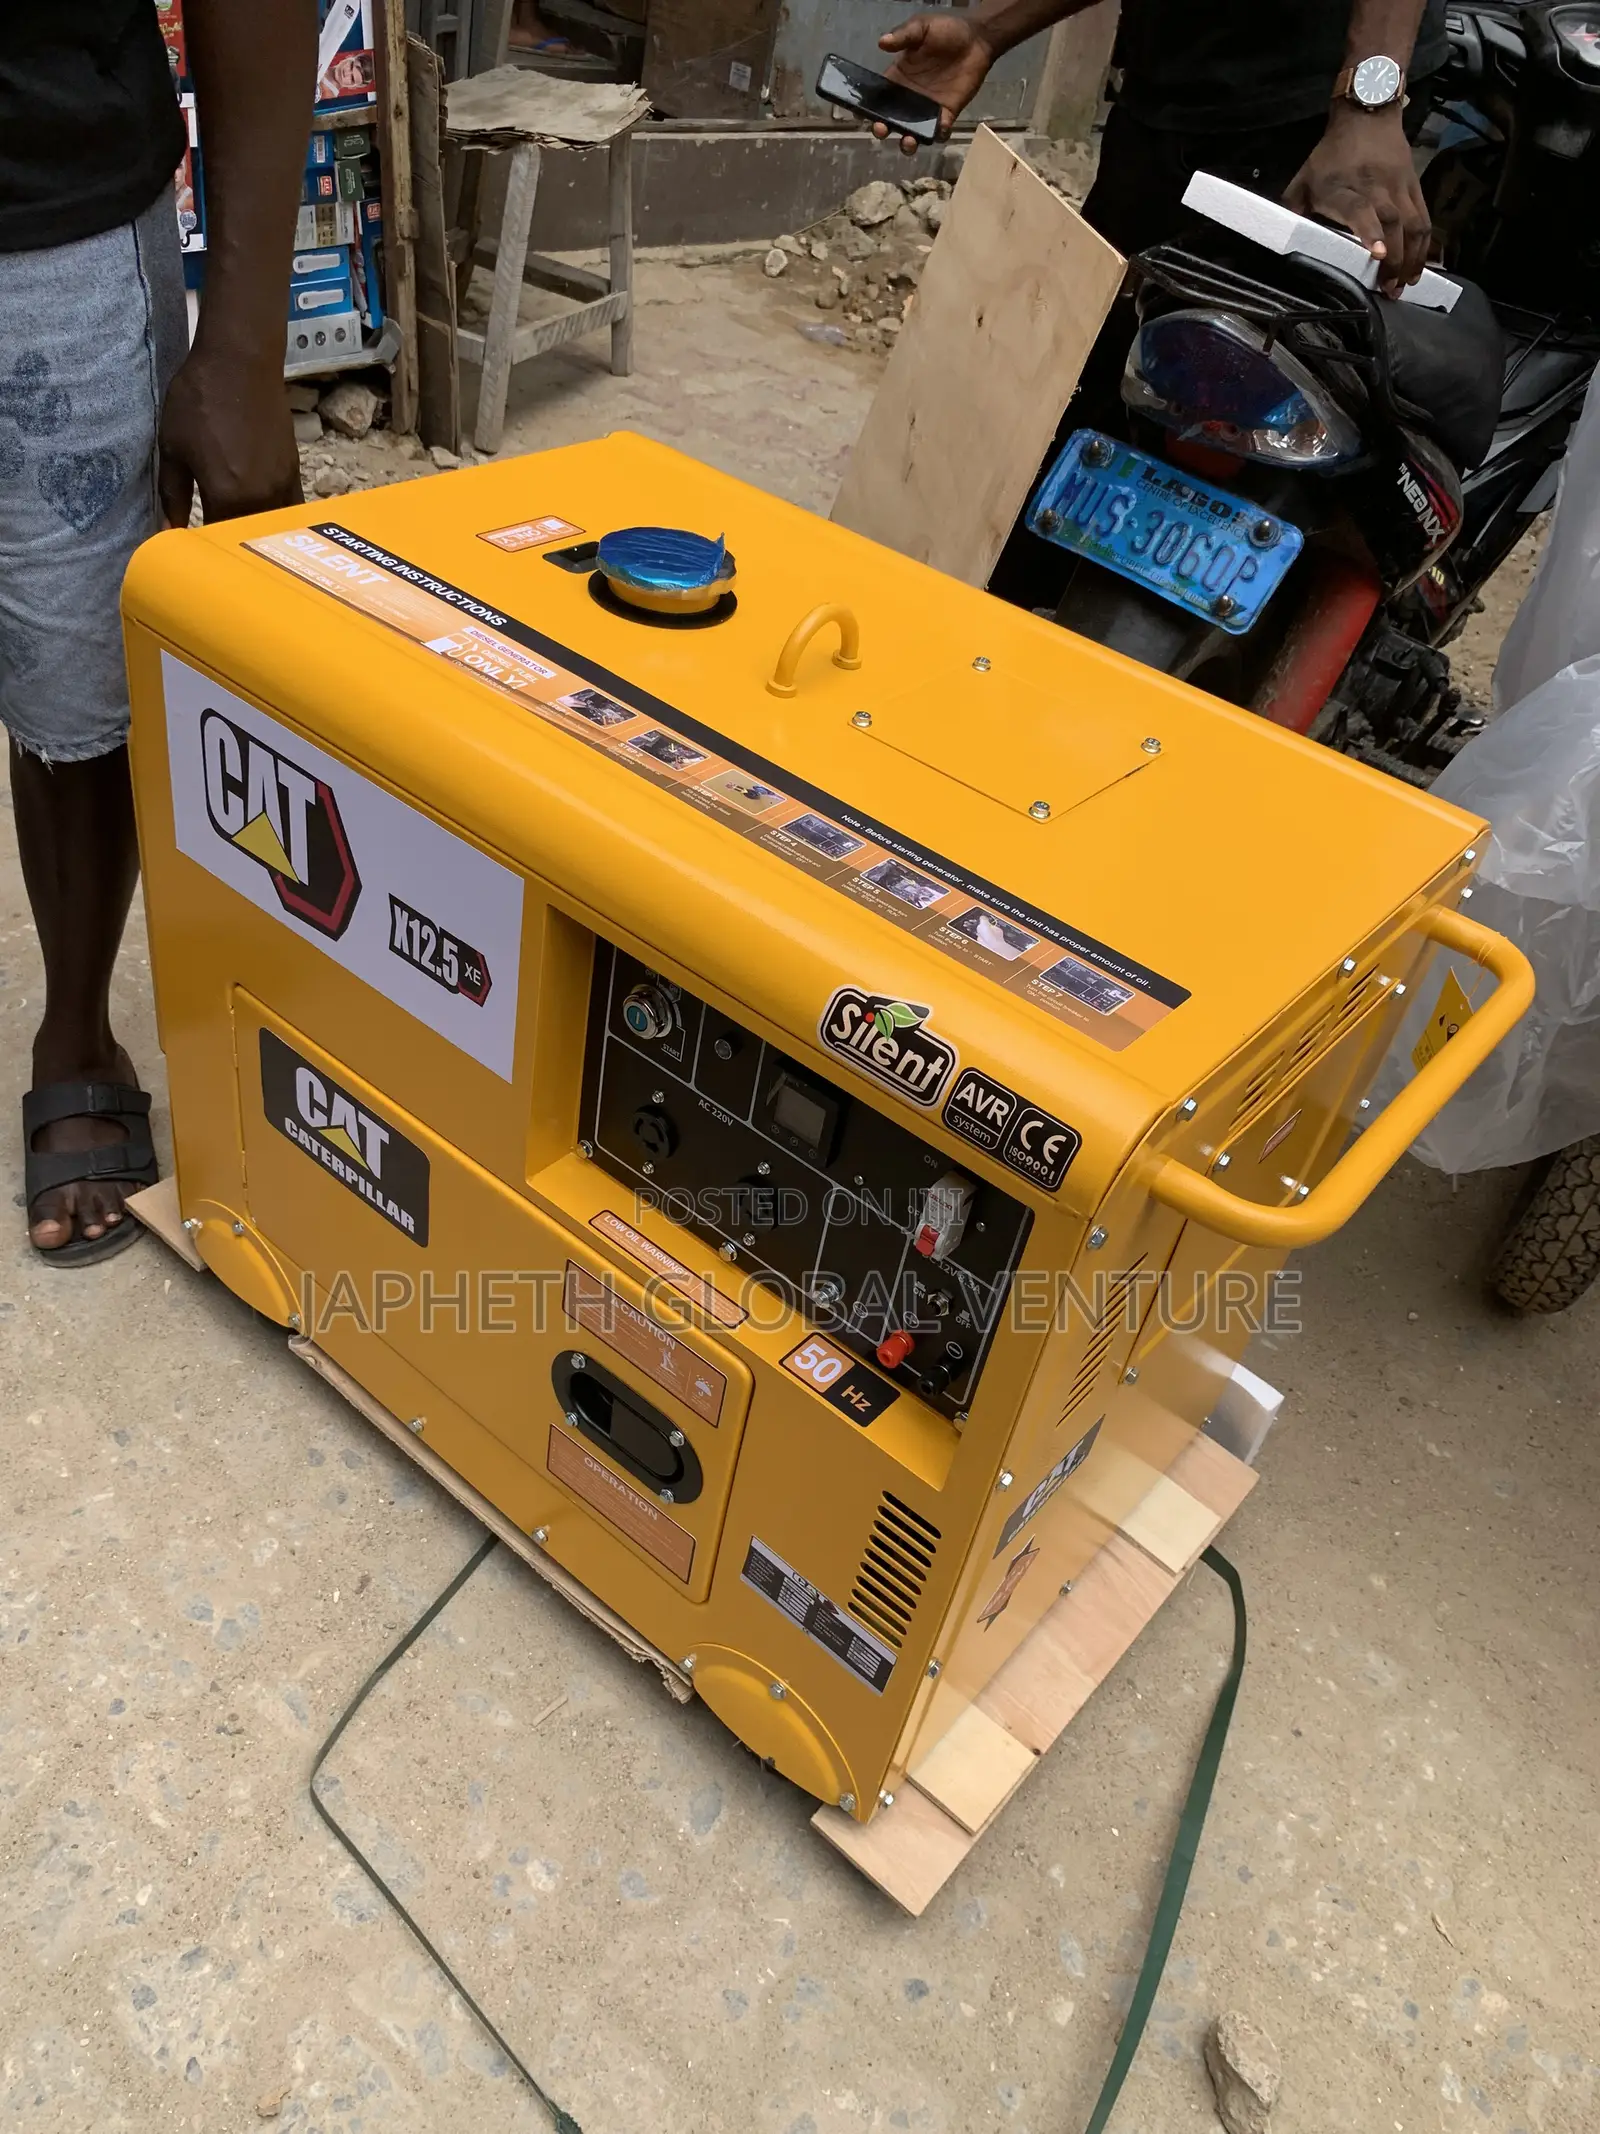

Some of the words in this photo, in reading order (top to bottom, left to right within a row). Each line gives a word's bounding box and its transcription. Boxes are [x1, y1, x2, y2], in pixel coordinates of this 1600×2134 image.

[1136, 479, 1172, 503] CENTRE
[1173, 498, 1188, 513] OF
[284, 535, 390, 585] SILENT
[323, 526, 399, 567] STARTING
[393, 563, 508, 627] INSTRUCTIONS
[463, 654, 529, 690] ONLY!
[470, 629, 497, 647] DIESEL
[498, 645, 548, 675] GENERATOR
[481, 649, 514, 669] DIESEL
[512, 667, 539, 684] FUEL
[618, 742, 637, 756] STEP
[204, 715, 316, 887] CAT
[692, 785, 713, 798] STEP
[770, 829, 792, 843] STEP
[841, 814, 861, 829] Note
[865, 827, 893, 846] Before
[891, 842, 923, 863] starting
[966, 884, 991, 900] make
[990, 896, 1011, 911] sure
[1010, 907, 1026, 919] the
[1025, 915, 1044, 929] unit
[1042, 924, 1060, 939] has
[1058, 934, 1092, 956] proper
[1089, 951, 1127, 975] amount
[1124, 970, 1138, 980] of
[852, 877, 875, 890] STEP
[393, 903, 460, 988] X12.5
[464, 960, 482, 987] XE
[939, 926, 963, 940] STEP
[1031, 978, 1056, 993] STEP
[662, 1043, 681, 1058] START
[830, 1002, 946, 1092] Silent
[296, 1066, 390, 1180] CAT
[698, 1098, 712, 1113] AC
[711, 1106, 734, 1127] 220V
[955, 1081, 1010, 1128] AVR
[952, 1112, 992, 1145] system
[1020, 1120, 1068, 1166] CE
[284, 1116, 415, 1235] CATERPILLAR
[923, 1154, 938, 1169] ON
[603, 1214, 627, 1233] LOW
[624, 1229, 640, 1245] OIL
[639, 1240, 689, 1278] WARNING!
[912, 1286, 926, 1300] ON
[620, 1304, 677, 1351] CAUTION
[955, 1314, 972, 1329] OFF
[794, 1342, 843, 1384] 50
[840, 1383, 873, 1413] Hz
[583, 1456, 659, 1521] OPERATION
